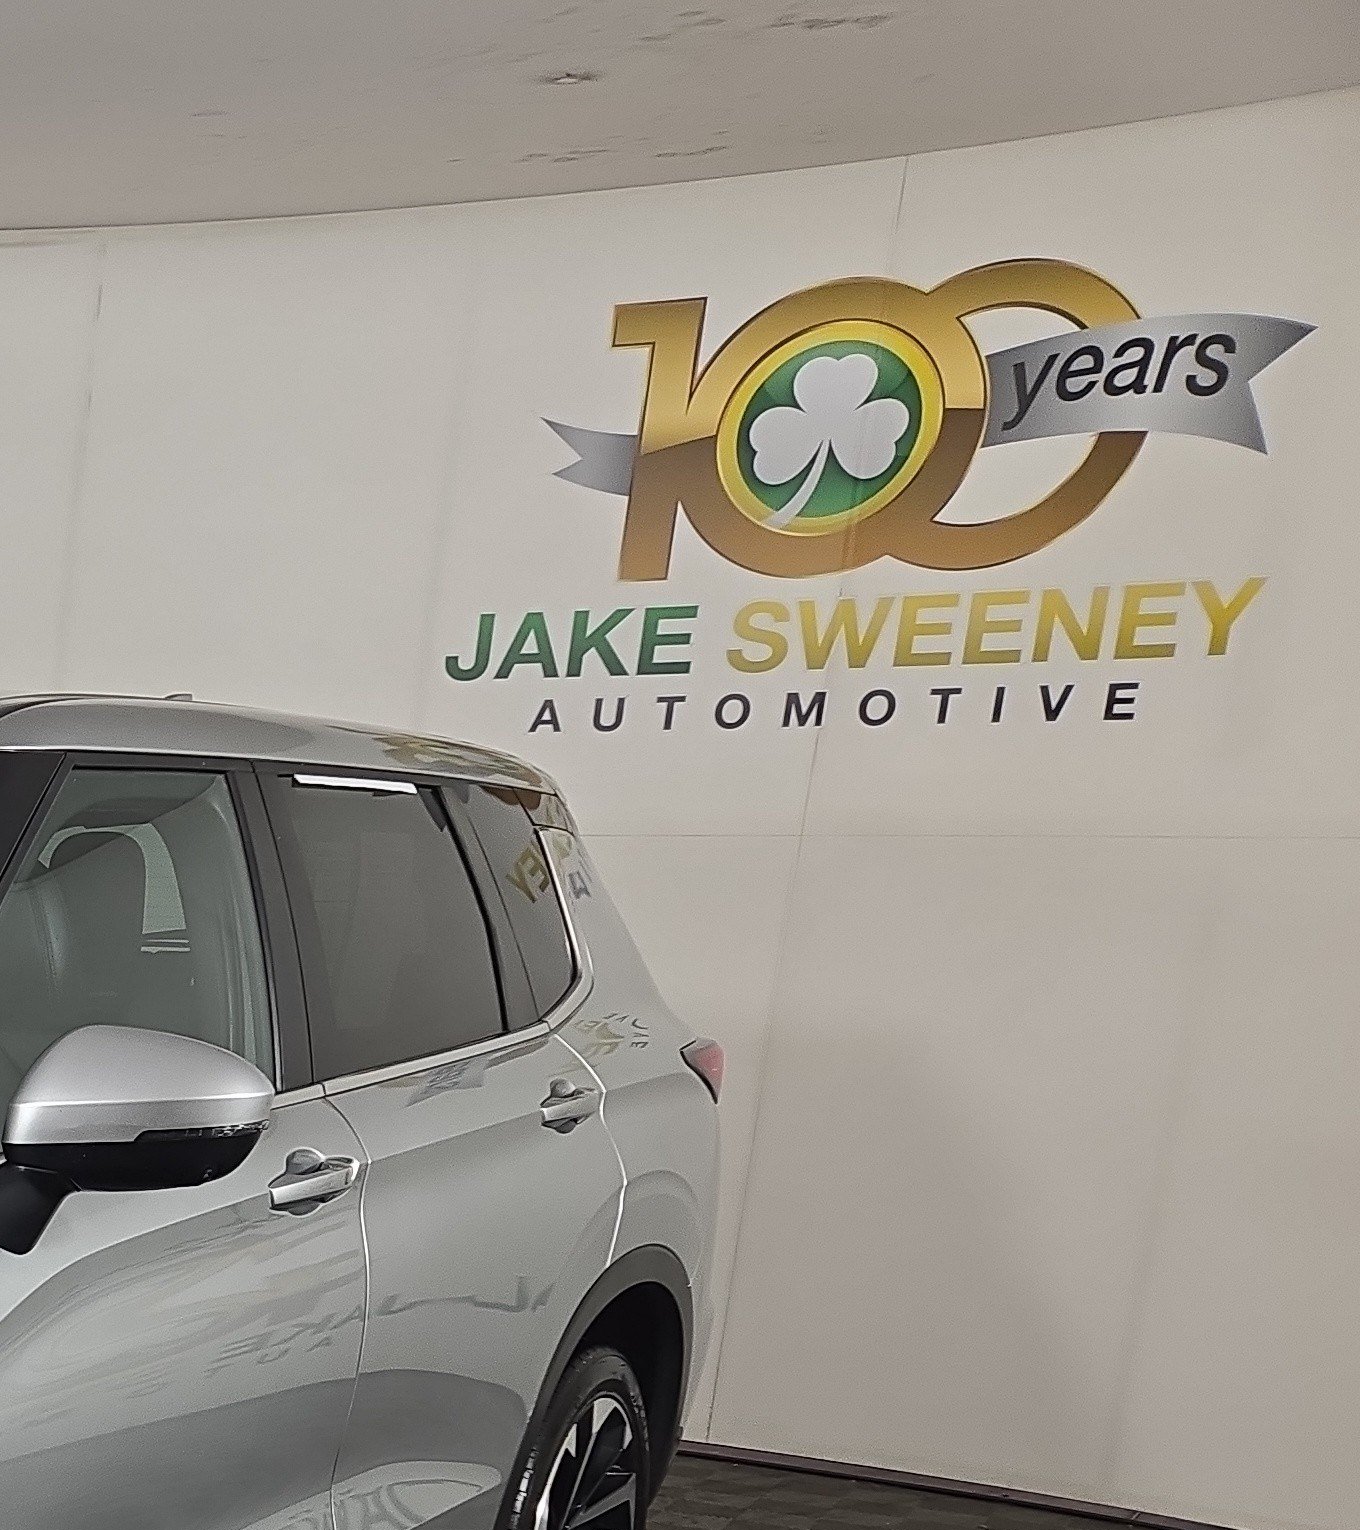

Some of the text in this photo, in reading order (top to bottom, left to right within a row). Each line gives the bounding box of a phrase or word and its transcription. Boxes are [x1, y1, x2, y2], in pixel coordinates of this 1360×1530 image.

[612, 258, 1236, 582] 100 years
[445, 576, 1270, 682] JAKE SWEENEY
[529, 682, 1142, 734] AUTOMOTIVE
